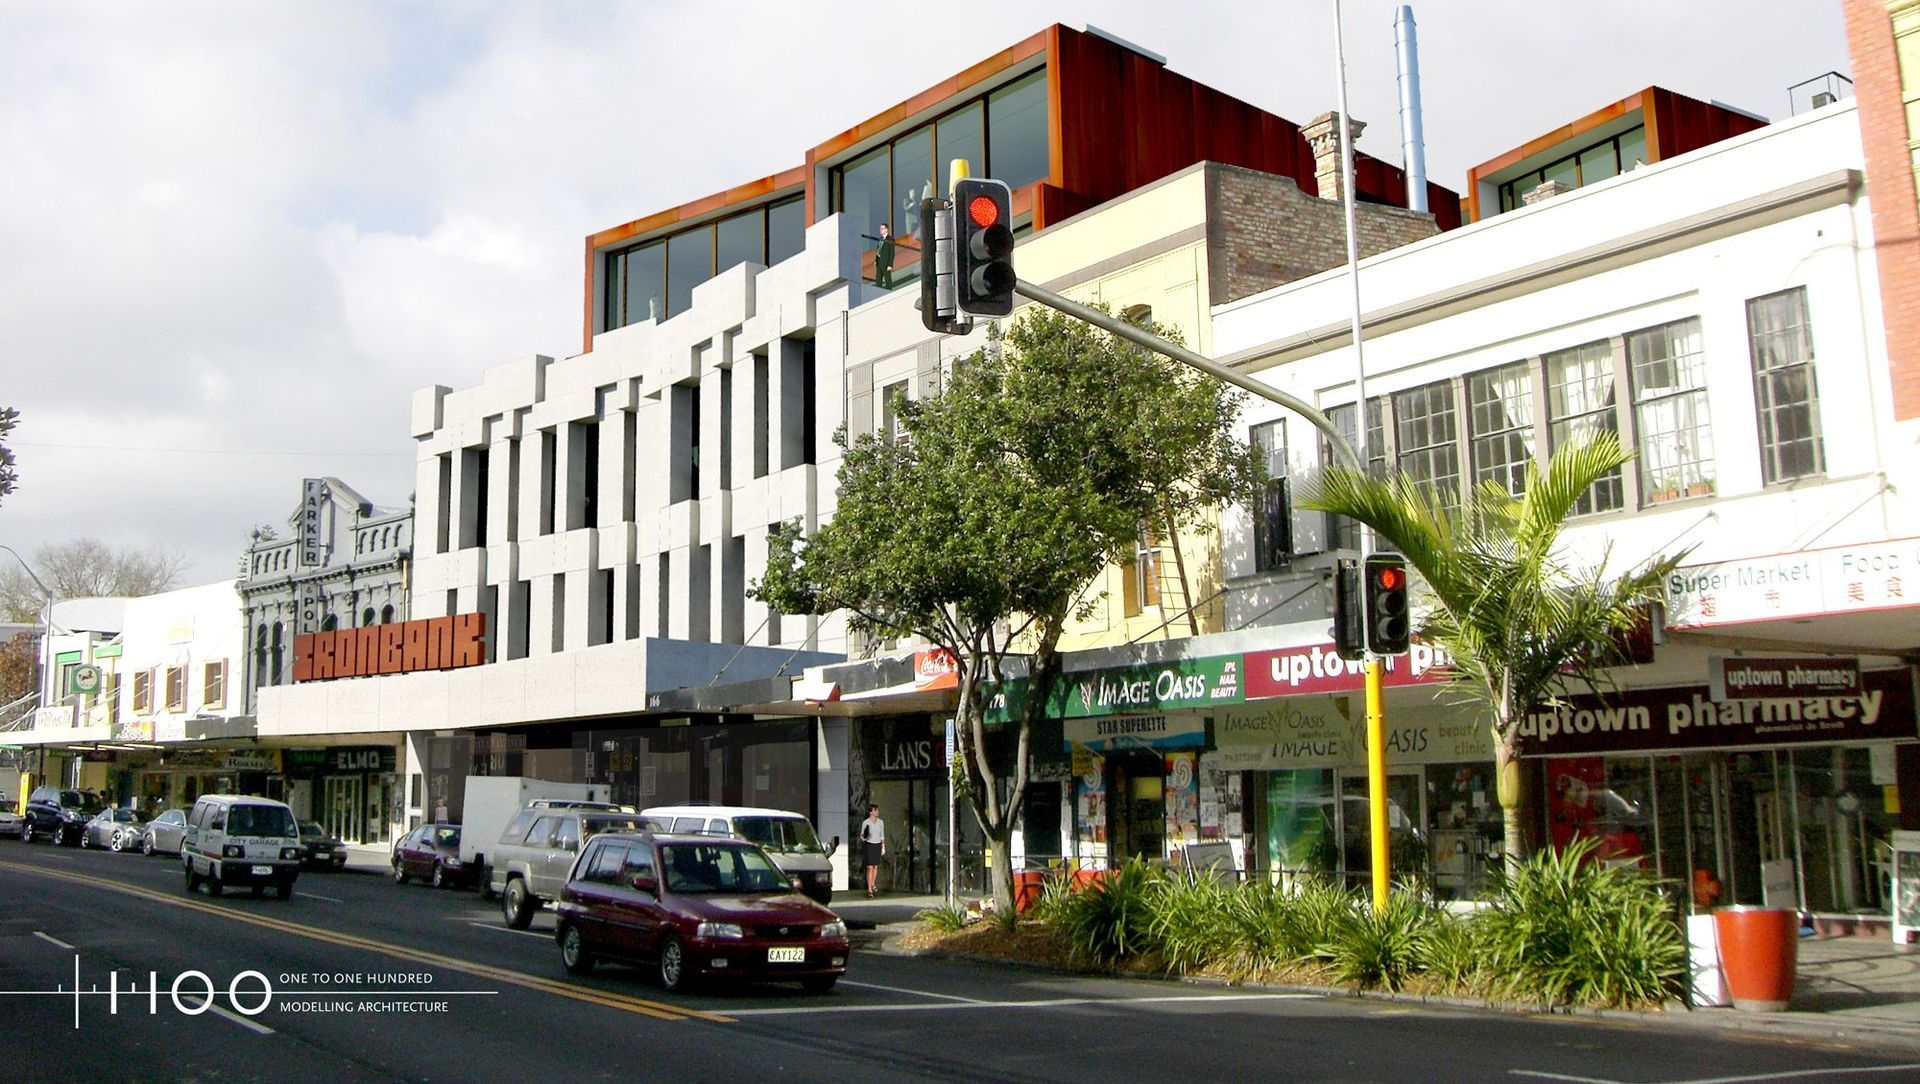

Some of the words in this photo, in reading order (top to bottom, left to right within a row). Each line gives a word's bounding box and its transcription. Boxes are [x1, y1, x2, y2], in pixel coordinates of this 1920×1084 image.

[1671, 574, 1730, 595] Super
[1738, 561, 1810, 587] Market
[1224, 662, 1236, 672] IPL
[1219, 674, 1236, 685] NAIL
[1728, 668, 1783, 689] uptown
[1787, 665, 1857, 688] pharmacy
[1097, 677, 1150, 706] IMAGE
[1155, 670, 1205, 701] OASIS
[1210, 686, 1237, 698] BEAUTY
[1224, 713, 1267, 733] IMAGE
[1519, 704, 1650, 742] uptown
[1667, 689, 1883, 735] pharmacy
[1097, 719, 1118, 735] STAR
[1120, 716, 1166, 734] SUPERETTE
[337, 751, 380, 770] ELMO
